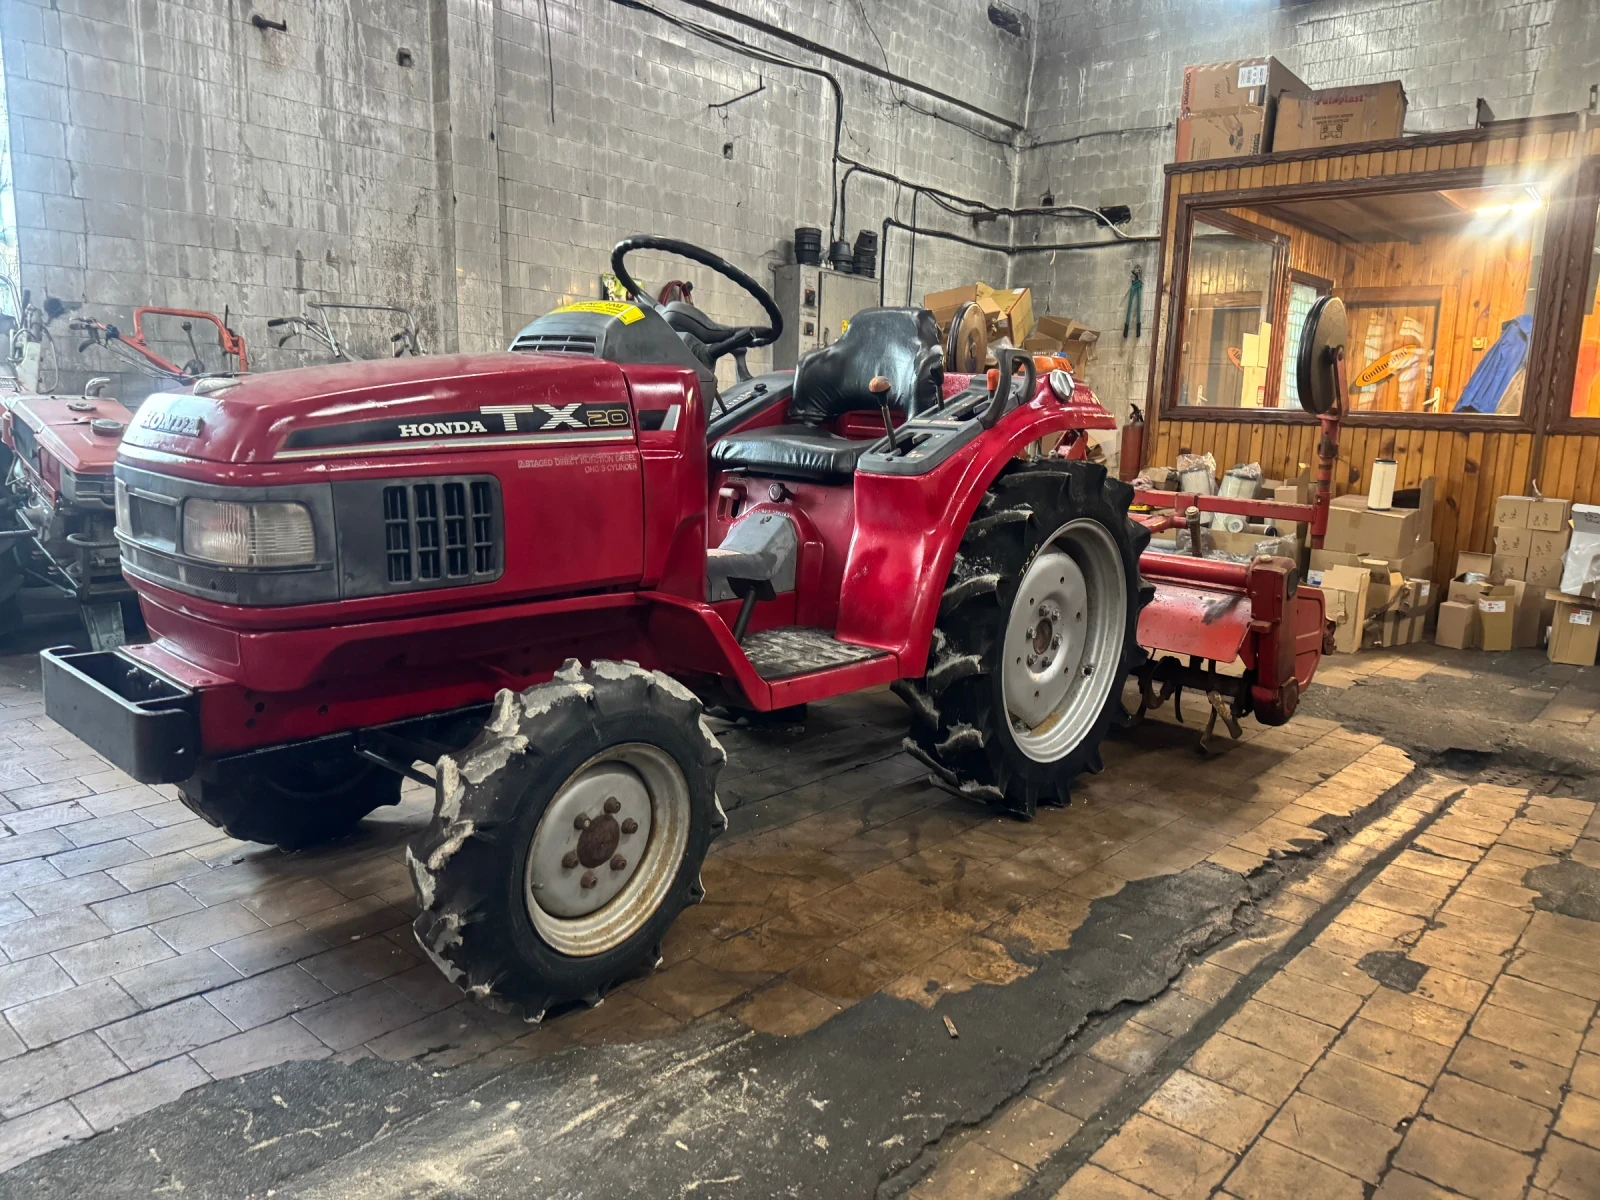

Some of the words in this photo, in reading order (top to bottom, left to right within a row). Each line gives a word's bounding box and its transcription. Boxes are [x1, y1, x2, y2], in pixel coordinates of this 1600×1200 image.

[1183, 72, 1192, 105] DAEWOO
[398, 420, 488, 437] HONDA
[554, 456, 580, 466] DIRECT
[580, 453, 614, 465] INJECTION
[615, 452, 637, 462] DIESEL
